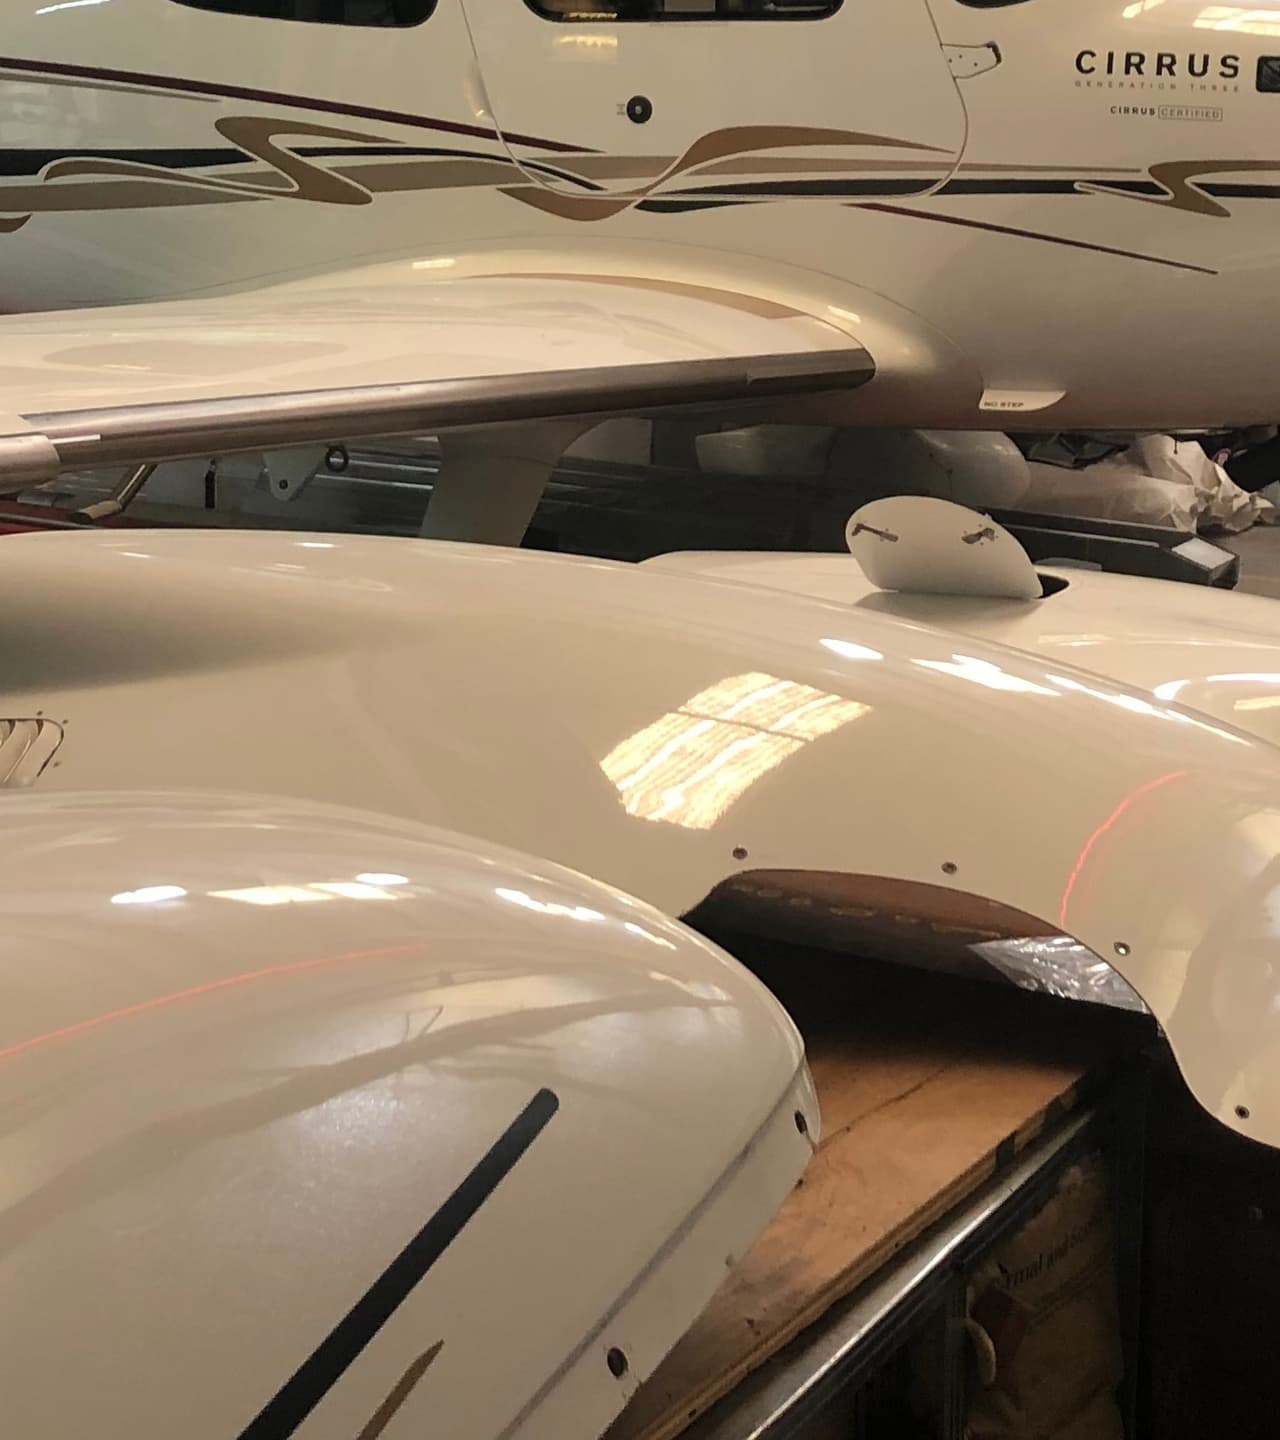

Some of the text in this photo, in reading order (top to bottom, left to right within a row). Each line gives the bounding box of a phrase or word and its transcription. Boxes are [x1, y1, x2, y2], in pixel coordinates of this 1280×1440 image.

[1075, 50, 1241, 79] CIRRUS
[1075, 80, 1240, 93] GENERATION THREE
[1110, 105, 1220, 119] CIRRUS CERTIFIED
